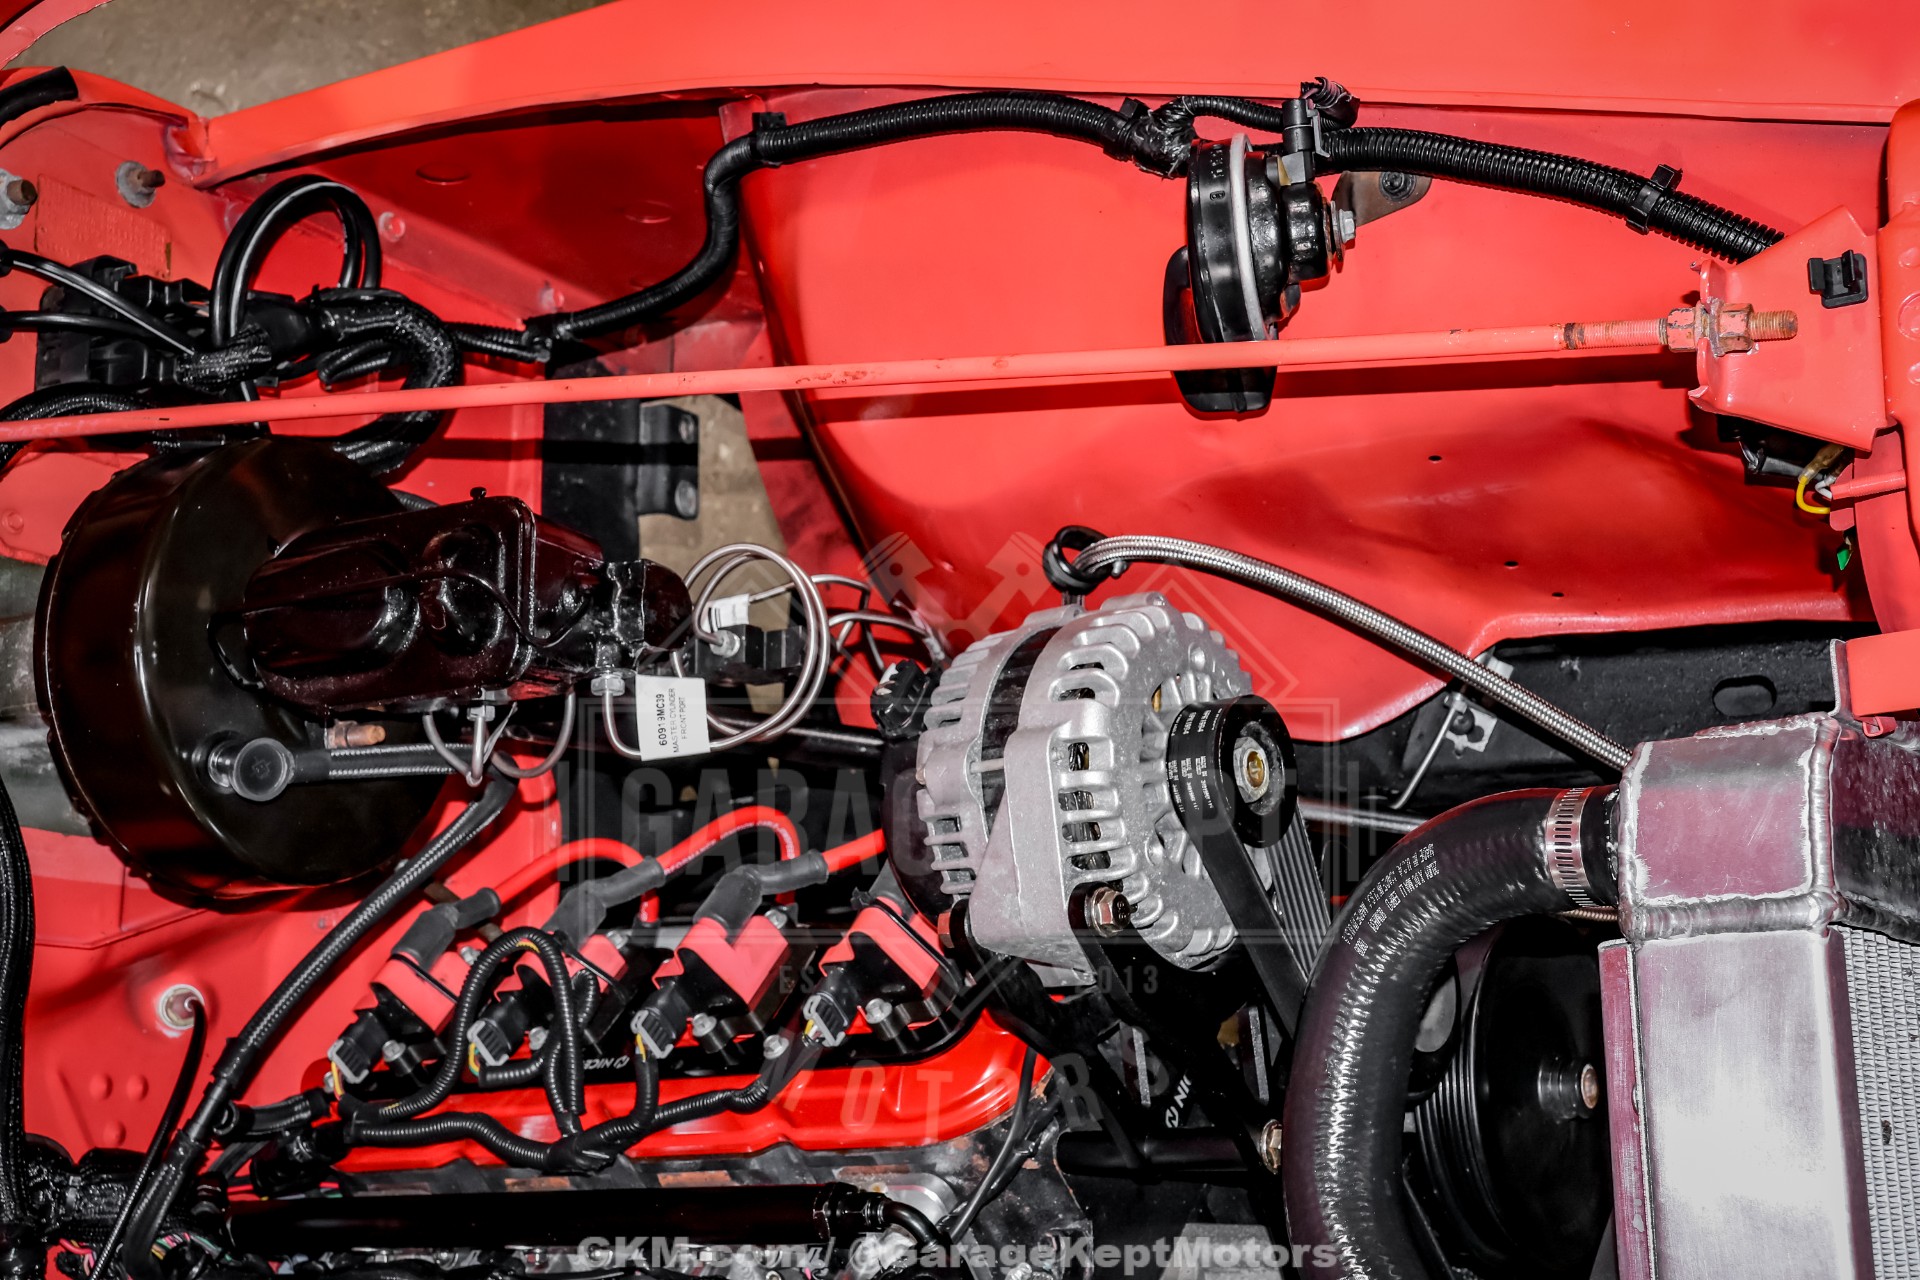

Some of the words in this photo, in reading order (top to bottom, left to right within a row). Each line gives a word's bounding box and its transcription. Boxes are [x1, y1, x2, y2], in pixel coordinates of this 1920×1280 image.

[656, 694, 667, 746] 60919MC39
[669, 688, 677, 719] CYLINDER
[670, 720, 680, 753] MASTER
